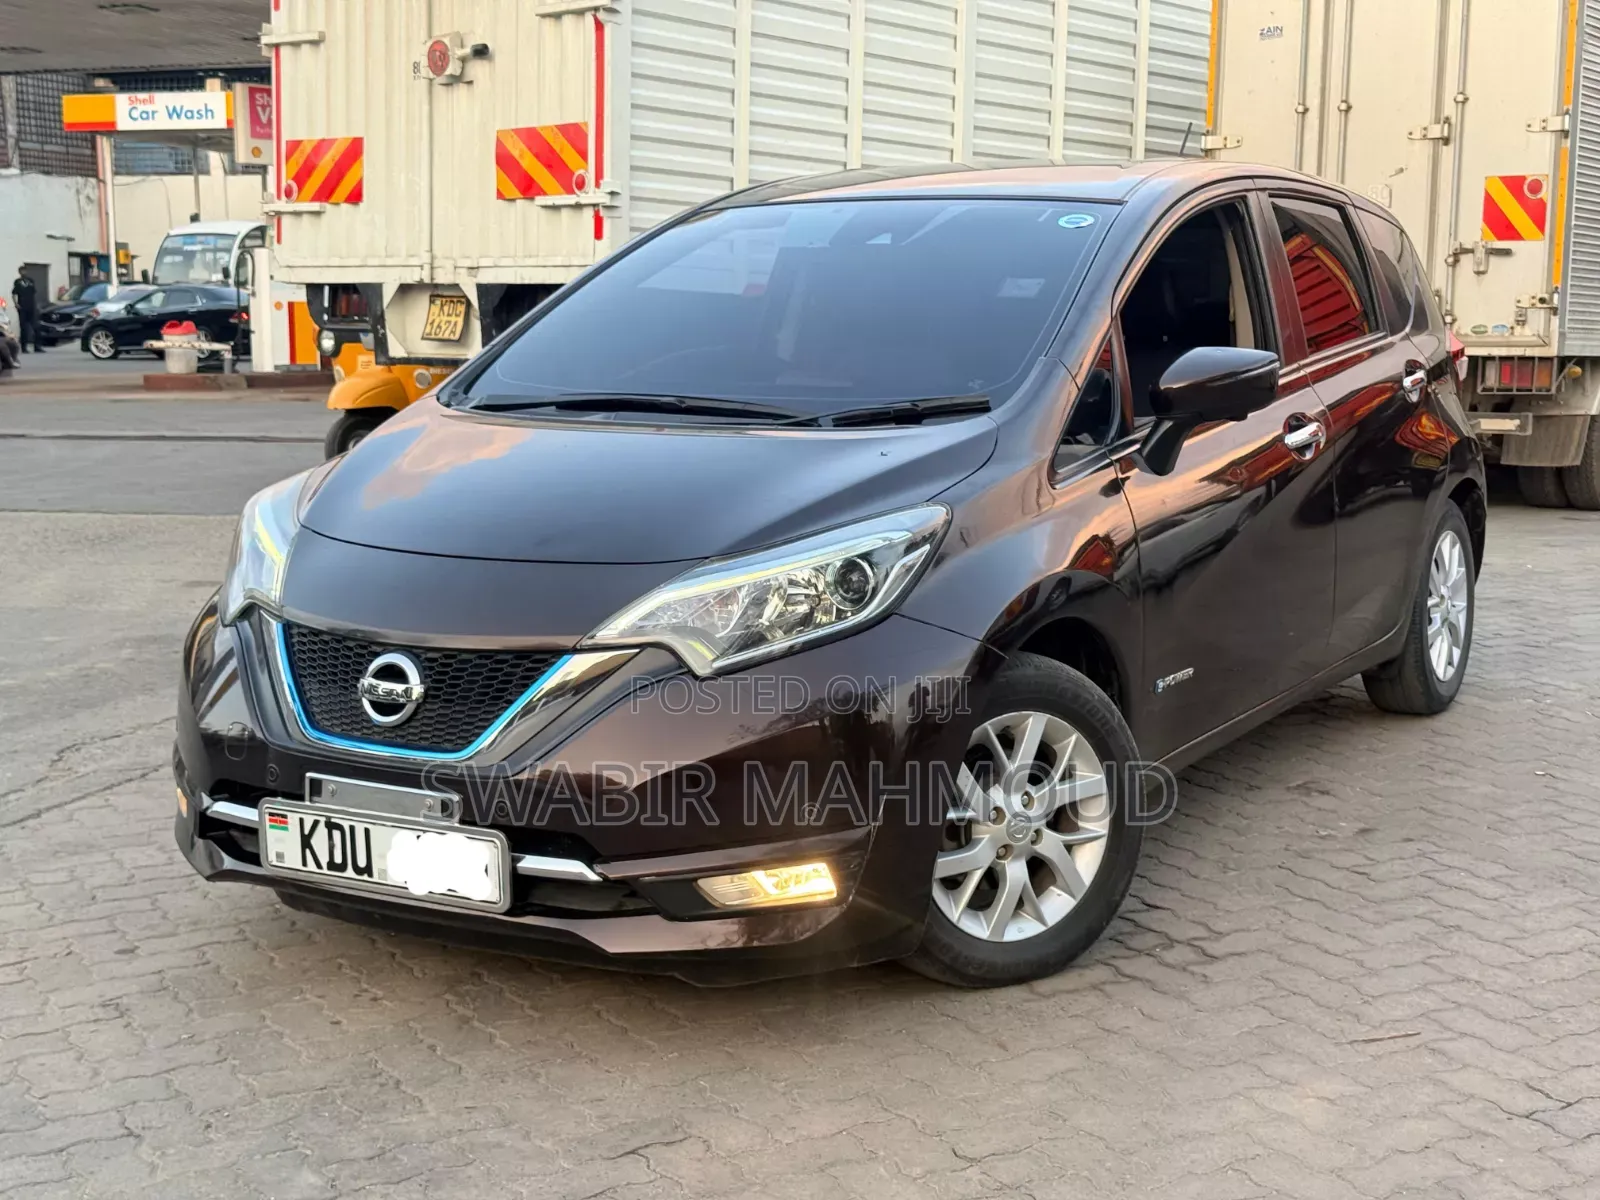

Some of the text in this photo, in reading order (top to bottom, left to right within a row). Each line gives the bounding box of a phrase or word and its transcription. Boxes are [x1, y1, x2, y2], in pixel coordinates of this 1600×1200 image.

[127, 95, 155, 106] Shell
[128, 103, 215, 121] Car Wash
[425, 319, 458, 337] 167A
[299, 816, 374, 879] KDU
